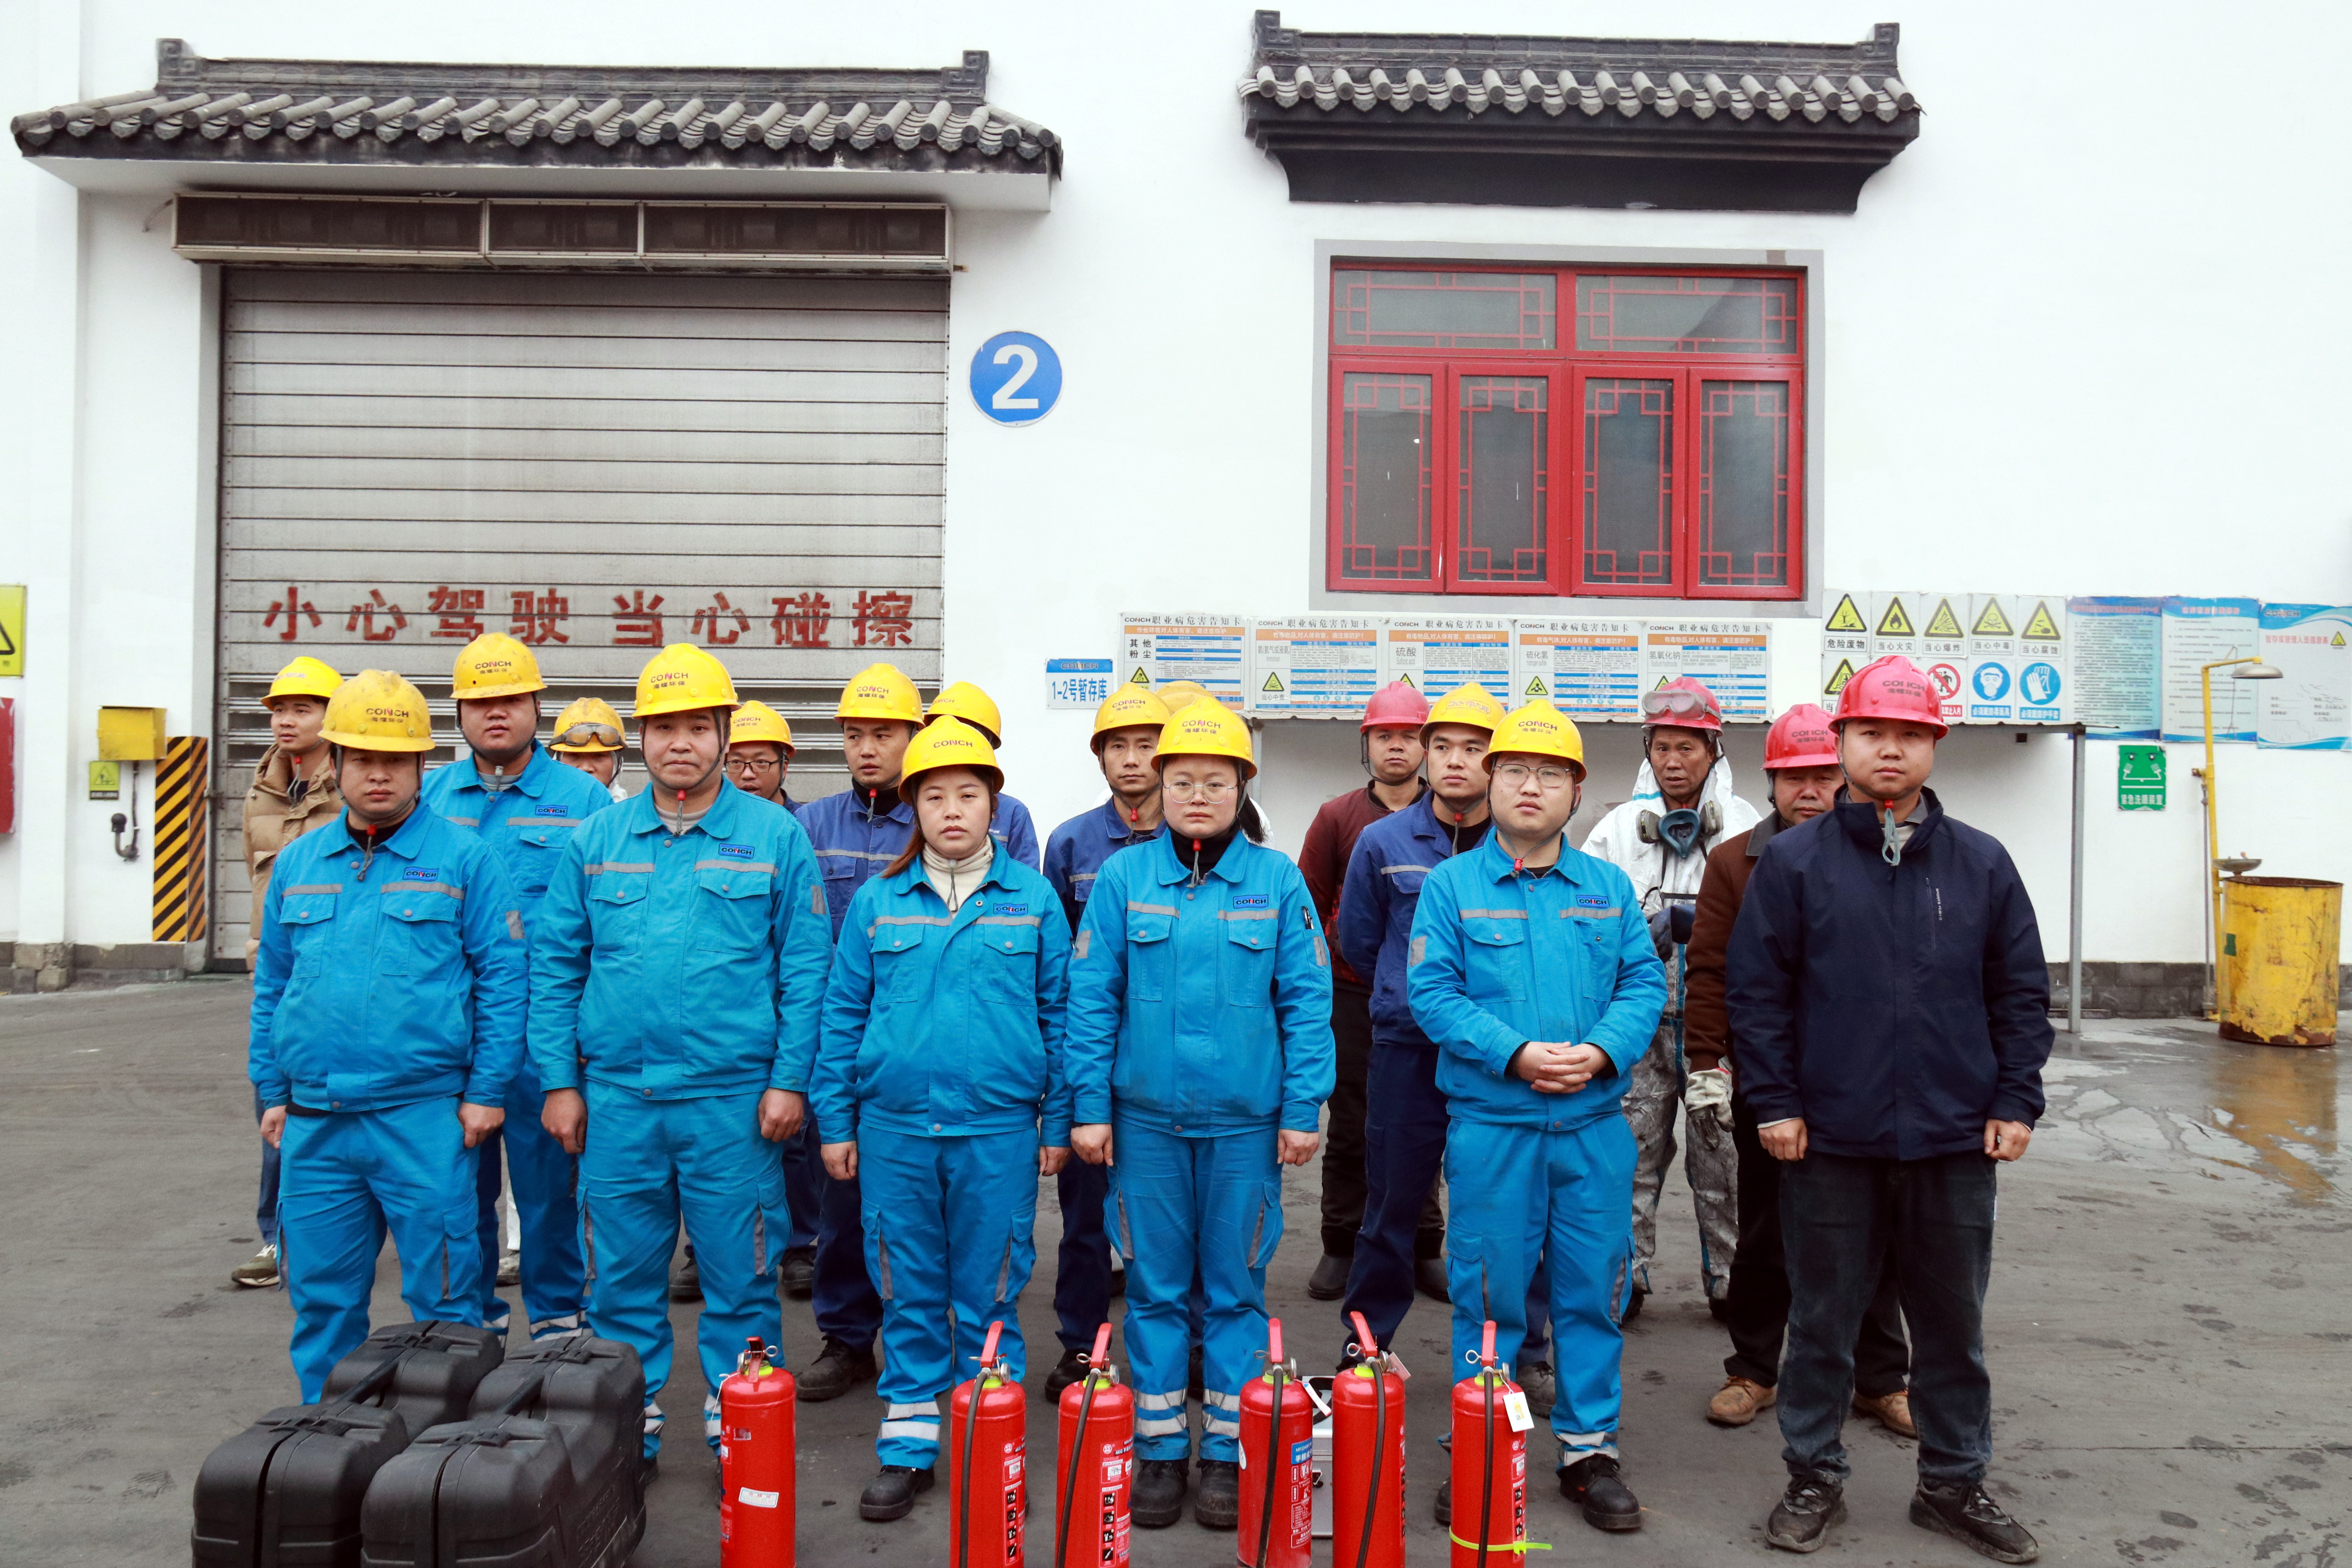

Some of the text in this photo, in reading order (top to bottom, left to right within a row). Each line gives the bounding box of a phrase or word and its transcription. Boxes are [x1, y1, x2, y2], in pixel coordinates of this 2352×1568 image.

[992, 344, 1039, 409] 2
[2265, 609, 2300, 617] CONCH
[1152, 616, 1241, 626] 职业病危害告知卡
[1287, 619, 1369, 628] 职业病危害告知卡
[1426, 620, 1503, 628] 职业病危害告知卡
[1550, 623, 1629, 632] 职业病危害告知卡
[1679, 624, 1761, 633] 职业病危害告知卡
[1129, 639, 1152, 648] 其他
[1827, 639, 1865, 649] 危险废物
[1878, 642, 1913, 650] 当心火灾
[1924, 643, 1961, 652] 当心爆炸
[1975, 641, 2010, 650] 当心中毒
[1396, 647, 1417, 657] 硫酸
[2022, 645, 2058, 654] 当心腐蚀
[1129, 650, 1152, 659] 粉尘
[1526, 651, 1548, 659] 硫化氢
[1649, 651, 1681, 659] 氢氧化钠
[475, 661, 512, 669] CONCH
[1061, 661, 1098, 670] CONCH
[651, 672, 689, 683] CONCH
[653, 681, 686, 690] 海螺环保
[857, 685, 889, 693] CONCH
[1052, 677, 1107, 702] 1-2号暂存库
[1112, 699, 1145, 708] CONCH
[366, 708, 409, 718] CONCH
[1182, 719, 1221, 729] CONCH
[1518, 720, 1558, 731] CONCH
[933, 739, 973, 748] CONCH
[721, 847, 752, 857] CONCH
[406, 870, 437, 879] CONCH
